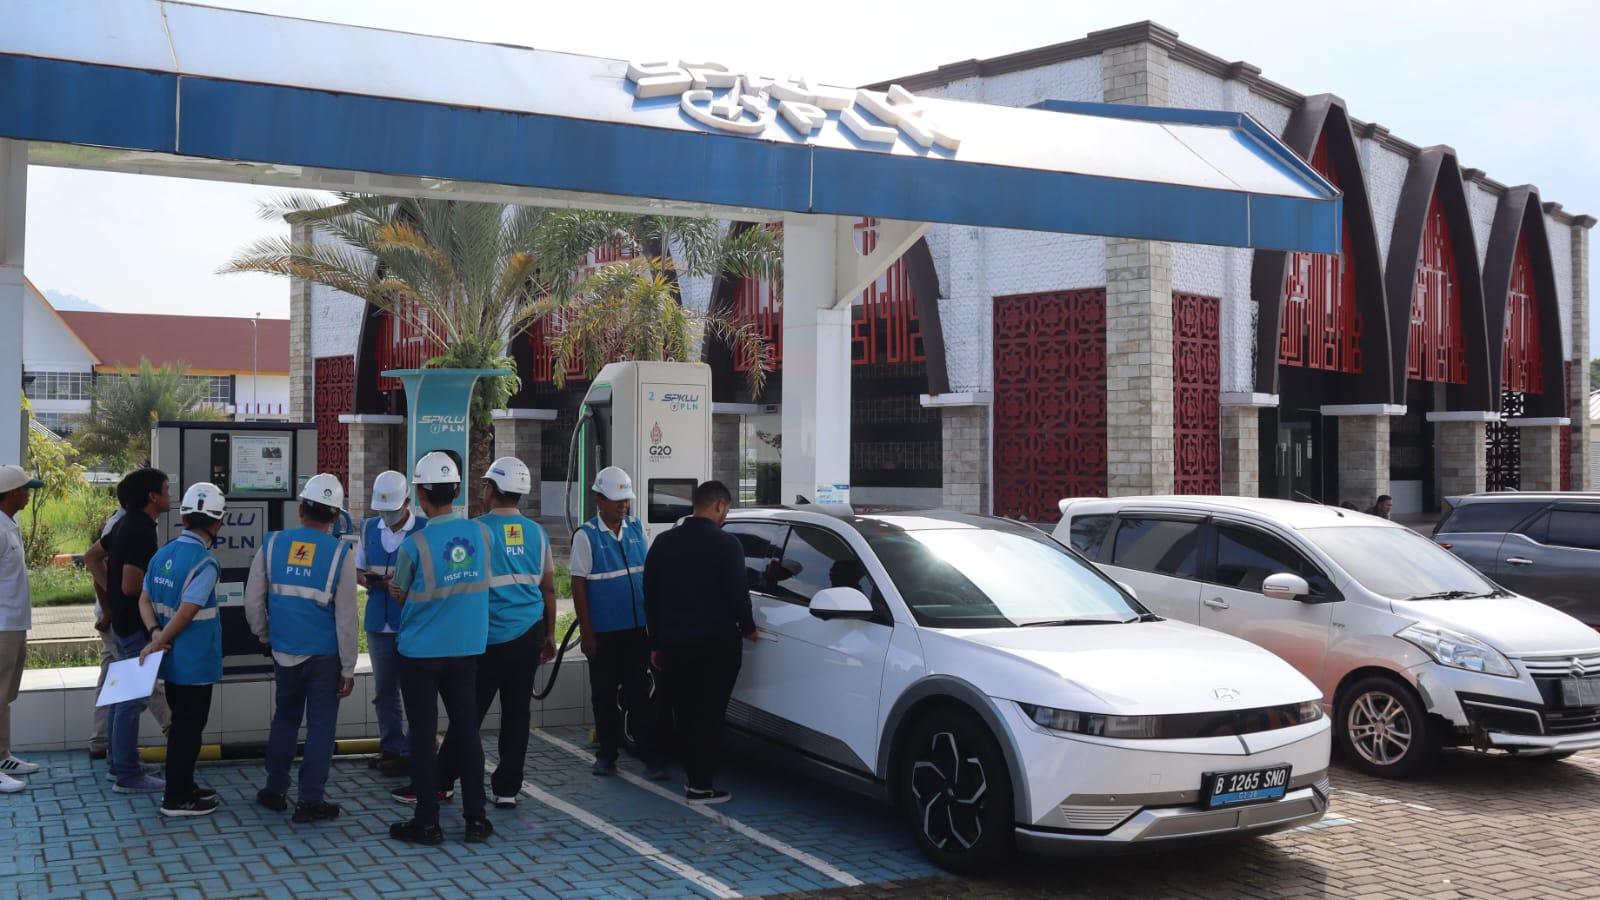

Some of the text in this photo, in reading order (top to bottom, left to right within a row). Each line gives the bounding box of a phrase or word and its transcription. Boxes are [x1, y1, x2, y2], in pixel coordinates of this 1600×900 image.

[648, 391, 655, 401] 2
[661, 393, 699, 402] SPKLU
[680, 402, 699, 411] PLN
[418, 415, 465, 424] SPKLU
[649, 445, 672, 456] G20
[212, 535, 255, 549] PLN
[506, 546, 525, 556] PLN
[286, 566, 312, 577] PLN
[463, 570, 479, 578] PLN
[1215, 777, 1225, 795] B
[1228, 772, 1261, 793] 1265
[1263, 769, 1286, 788] SNO
